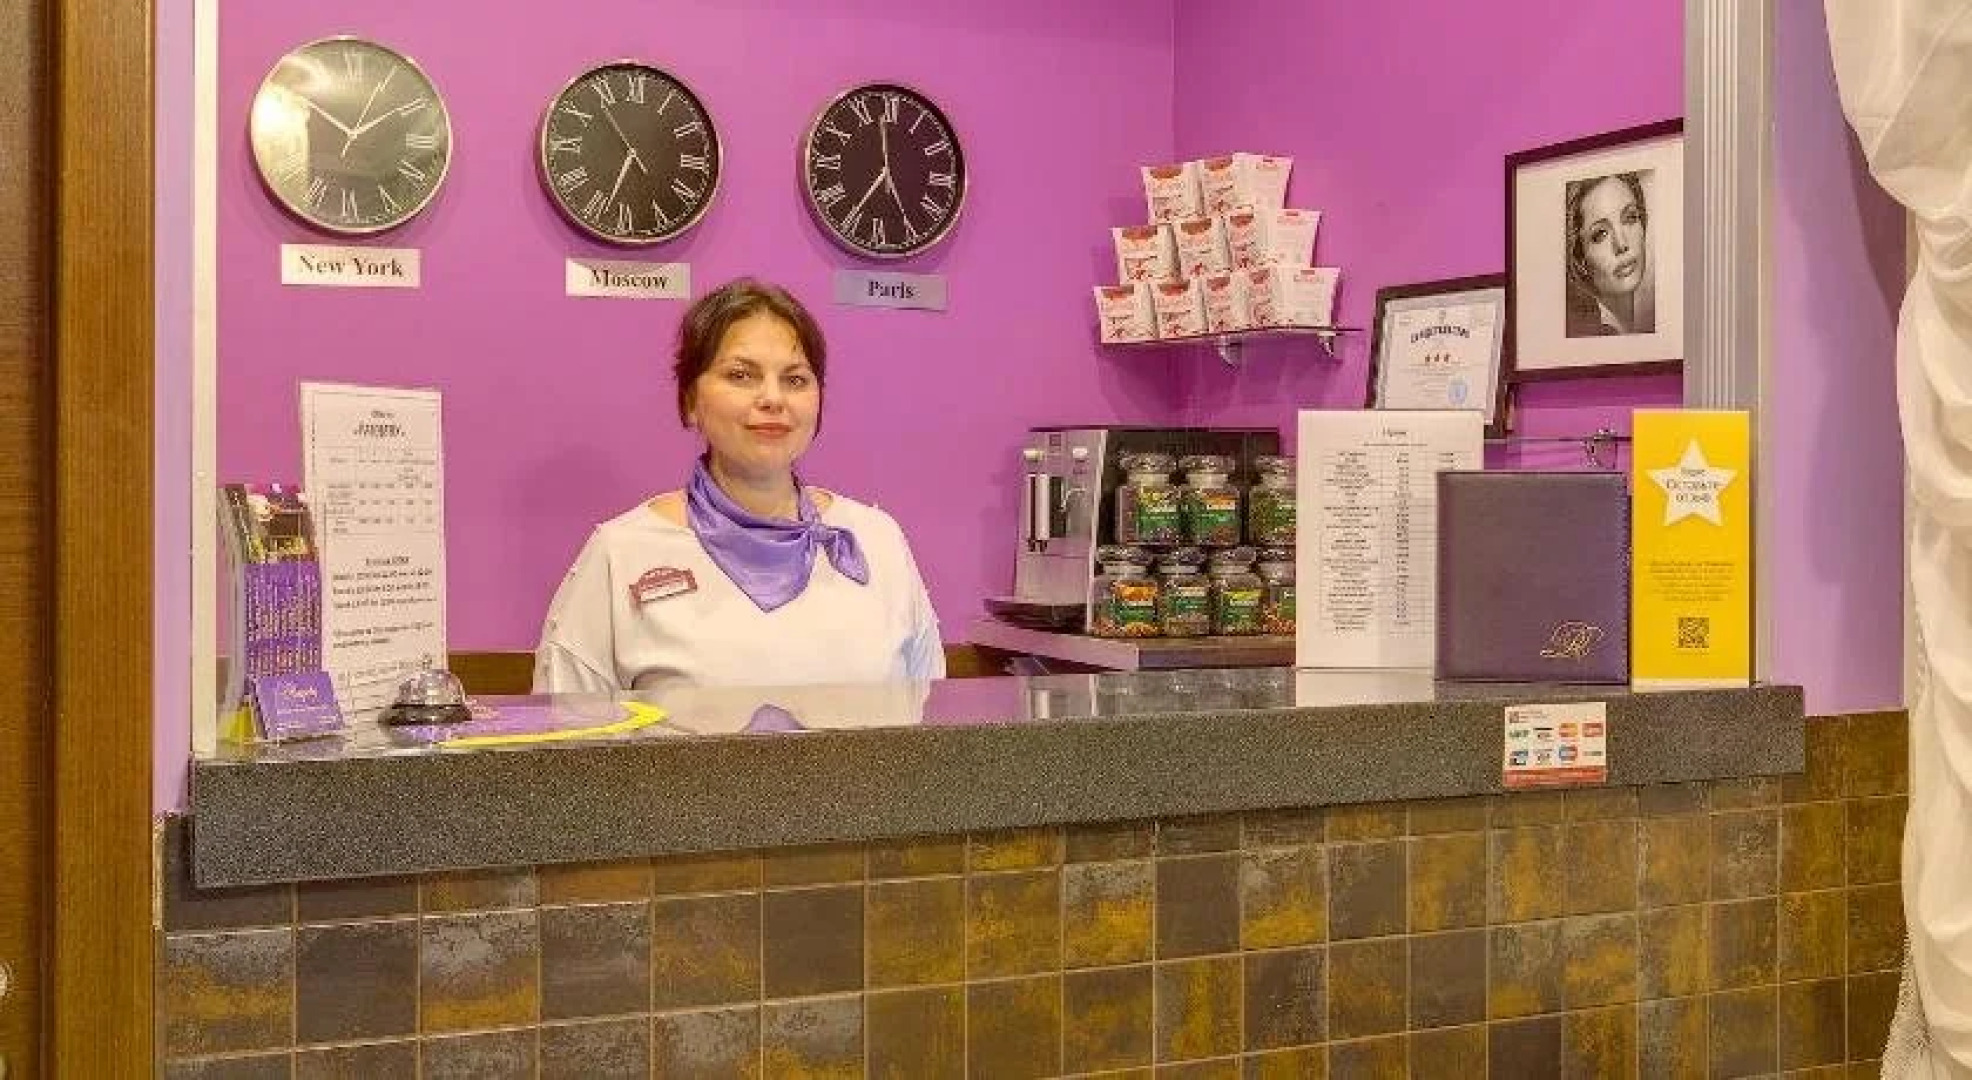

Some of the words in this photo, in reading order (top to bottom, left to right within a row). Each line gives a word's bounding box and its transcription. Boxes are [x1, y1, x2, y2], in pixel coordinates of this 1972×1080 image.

[299, 255, 346, 275] New
[353, 257, 404, 279] York
[590, 268, 668, 289] Moscow
[867, 280, 915, 300] Paris
